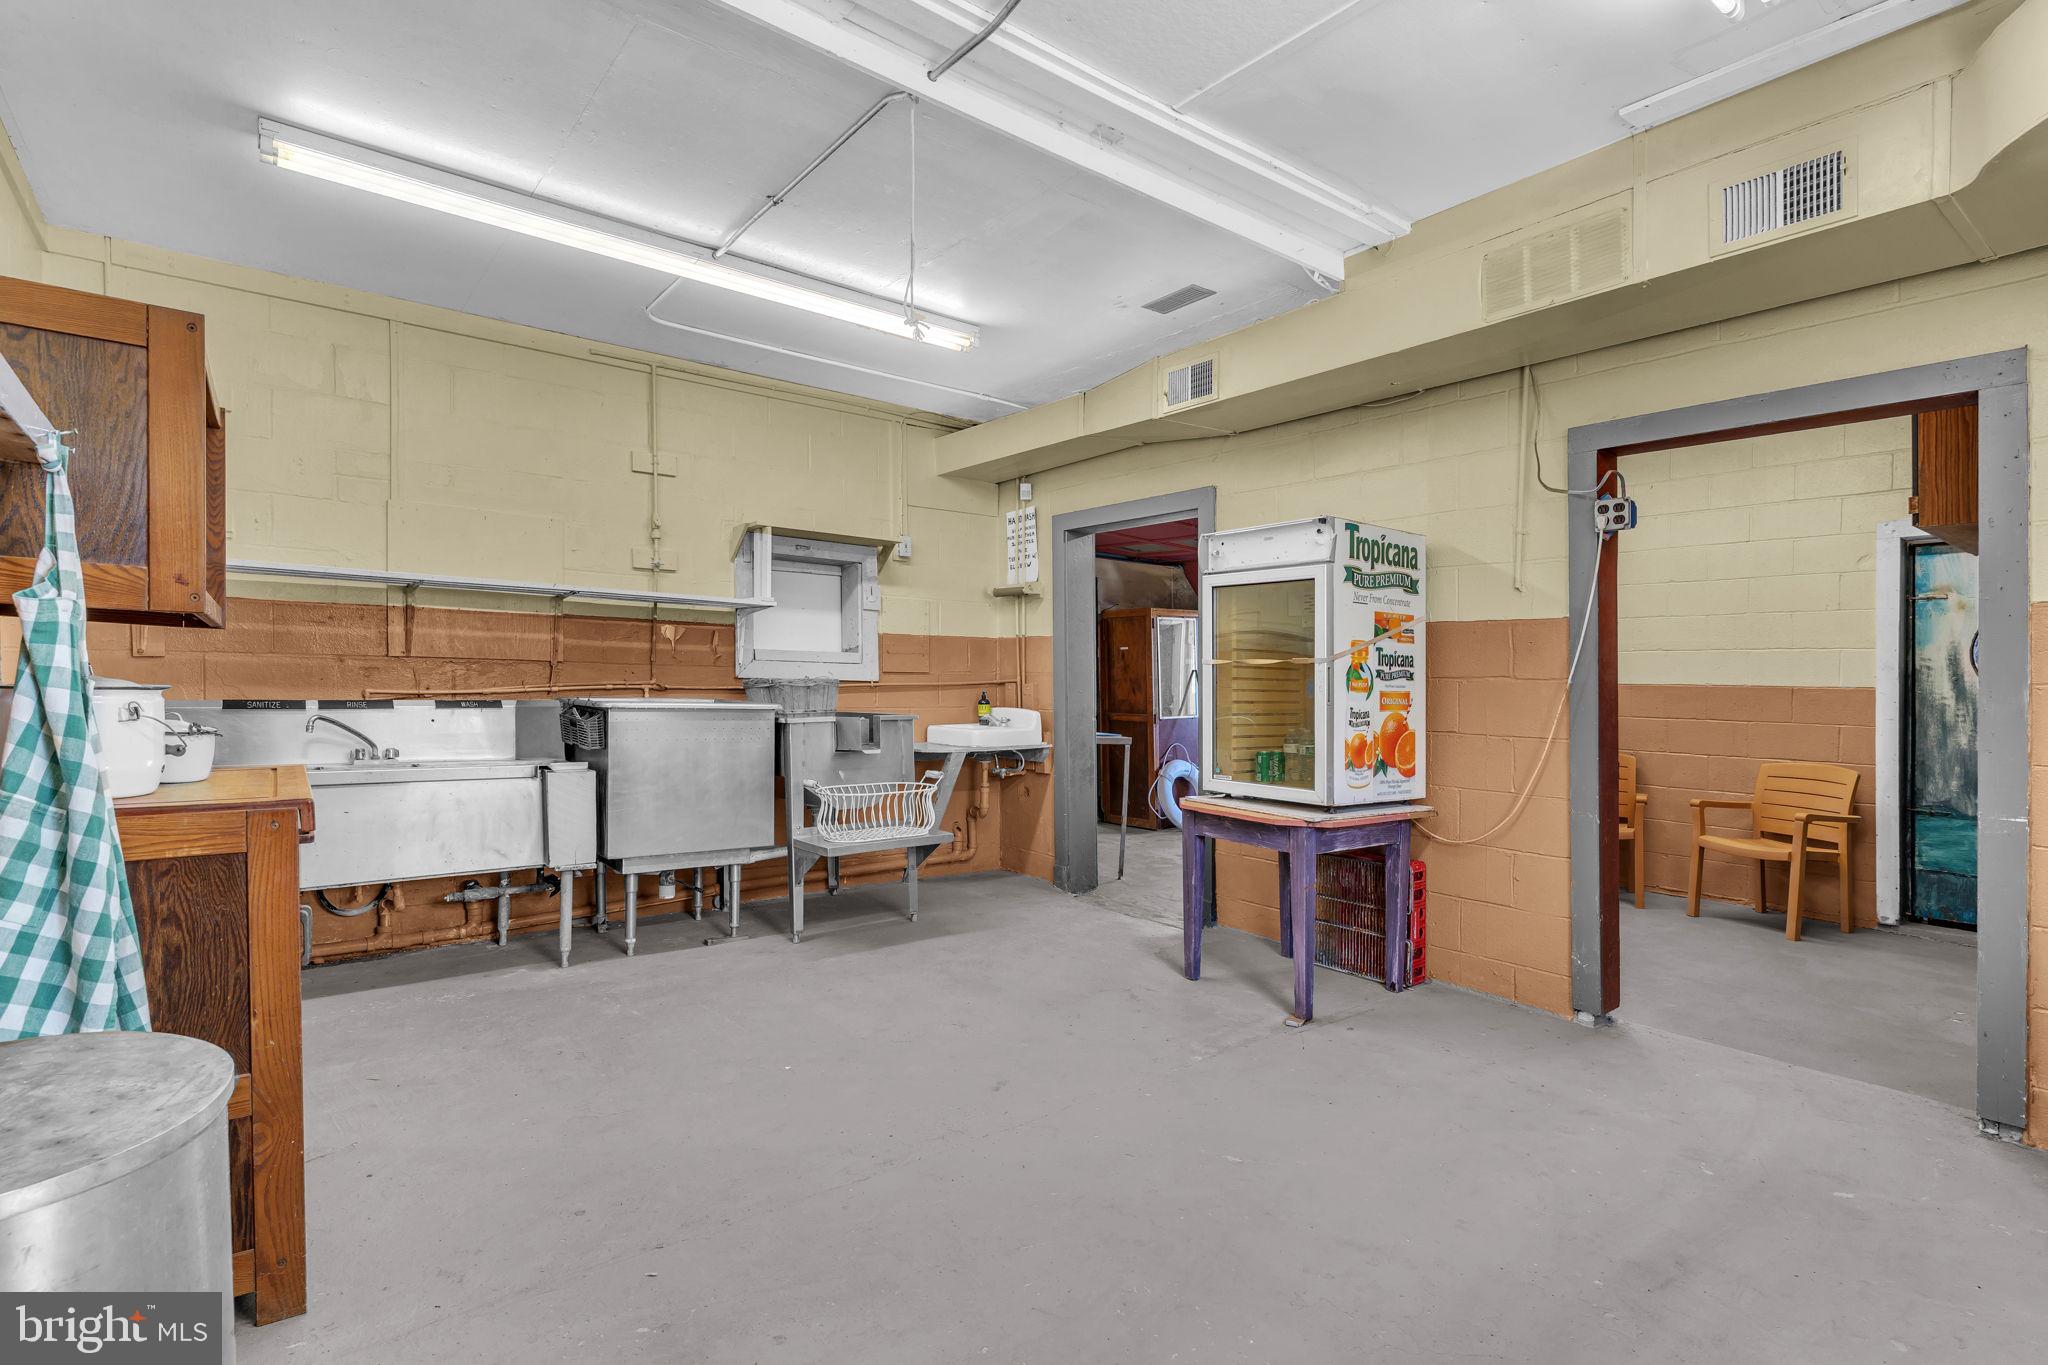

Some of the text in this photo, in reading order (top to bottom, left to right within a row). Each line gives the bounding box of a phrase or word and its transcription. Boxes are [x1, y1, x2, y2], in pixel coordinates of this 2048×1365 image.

[1345, 523, 1418, 570] Tropicana
[1353, 573, 1412, 588] PURE PREMIUM
[1353, 591, 1369, 601] Never
[1375, 647, 1414, 671] Tropicana
[246, 701, 281, 710] SANITIZE
[346, 701, 368, 709] RINSE
